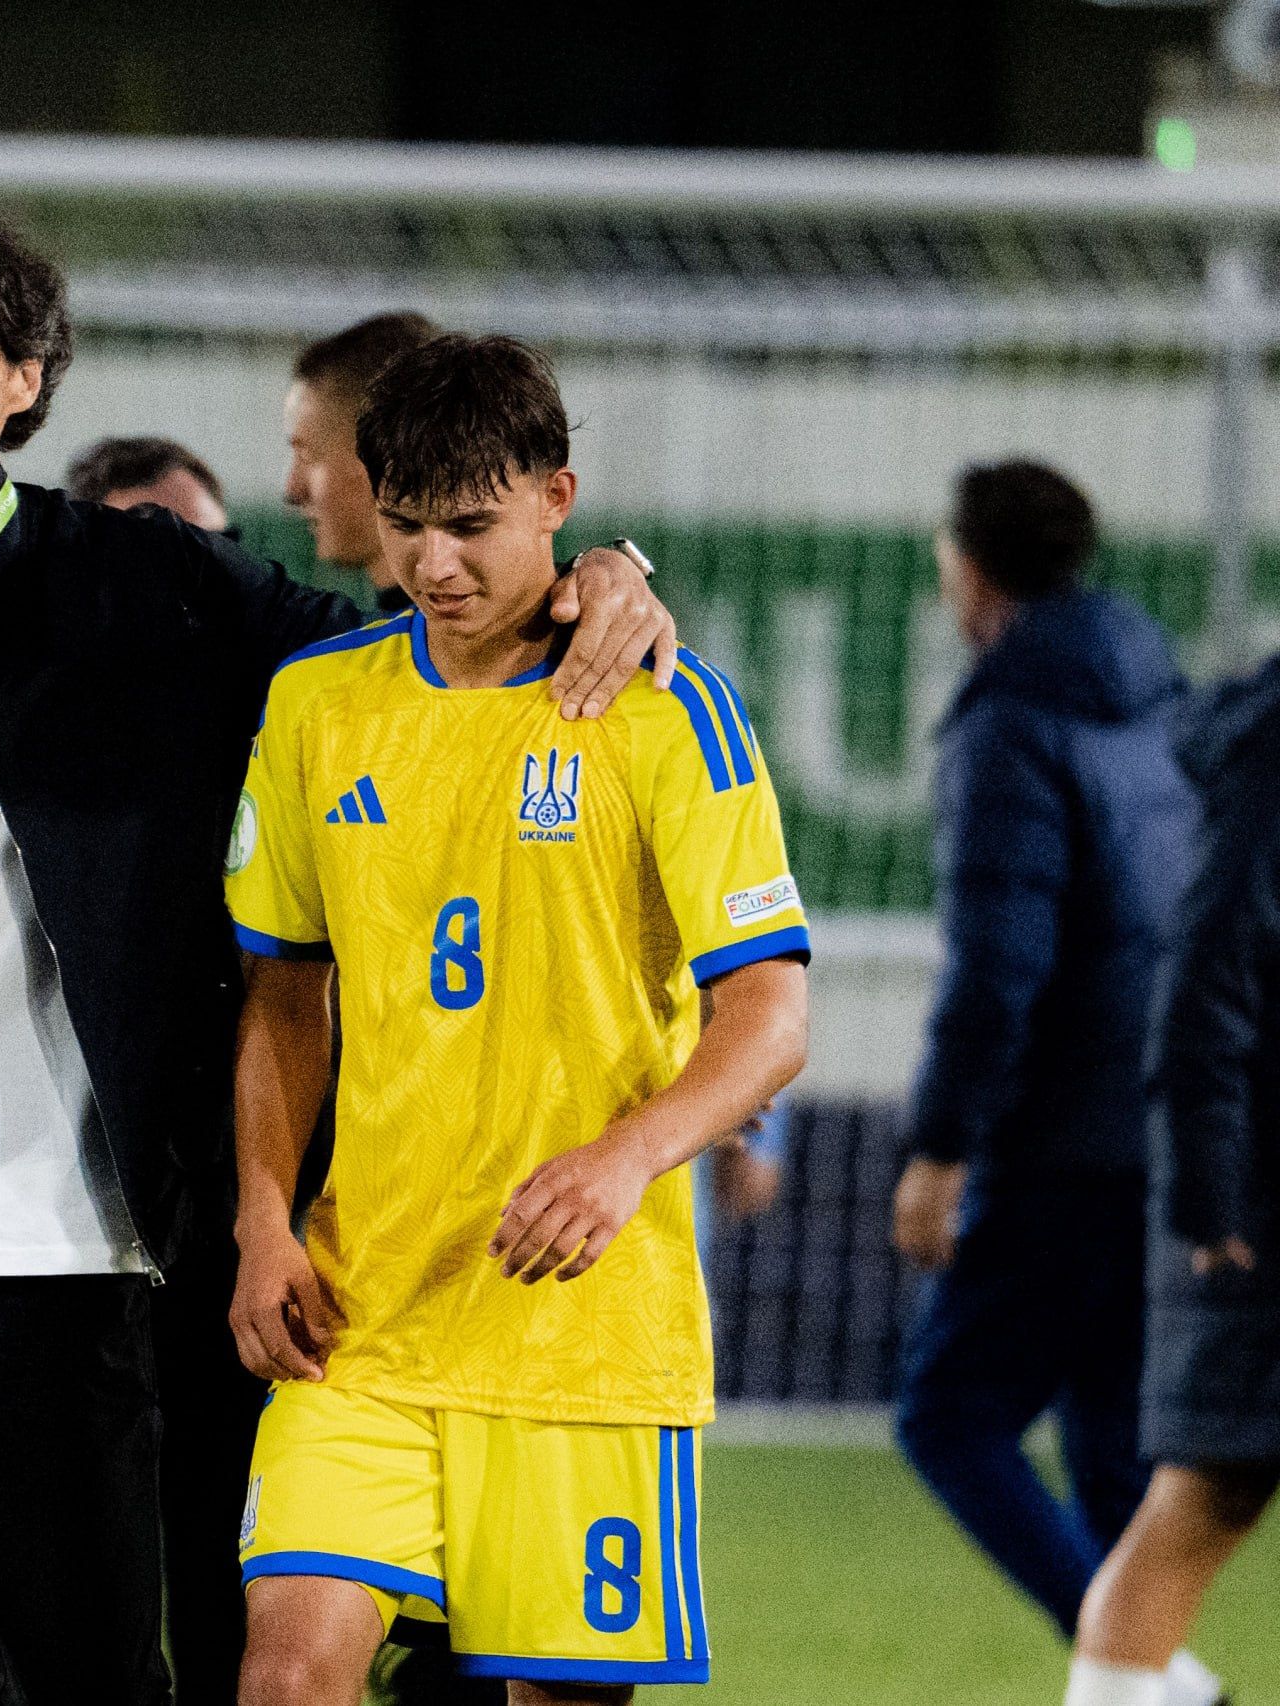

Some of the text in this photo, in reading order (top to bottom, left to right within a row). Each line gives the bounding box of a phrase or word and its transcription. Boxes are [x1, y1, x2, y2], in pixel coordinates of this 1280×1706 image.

[518, 830, 577, 842] UKRAINE
[430, 896, 486, 1011] 8
[583, 1516, 643, 1634] 8
